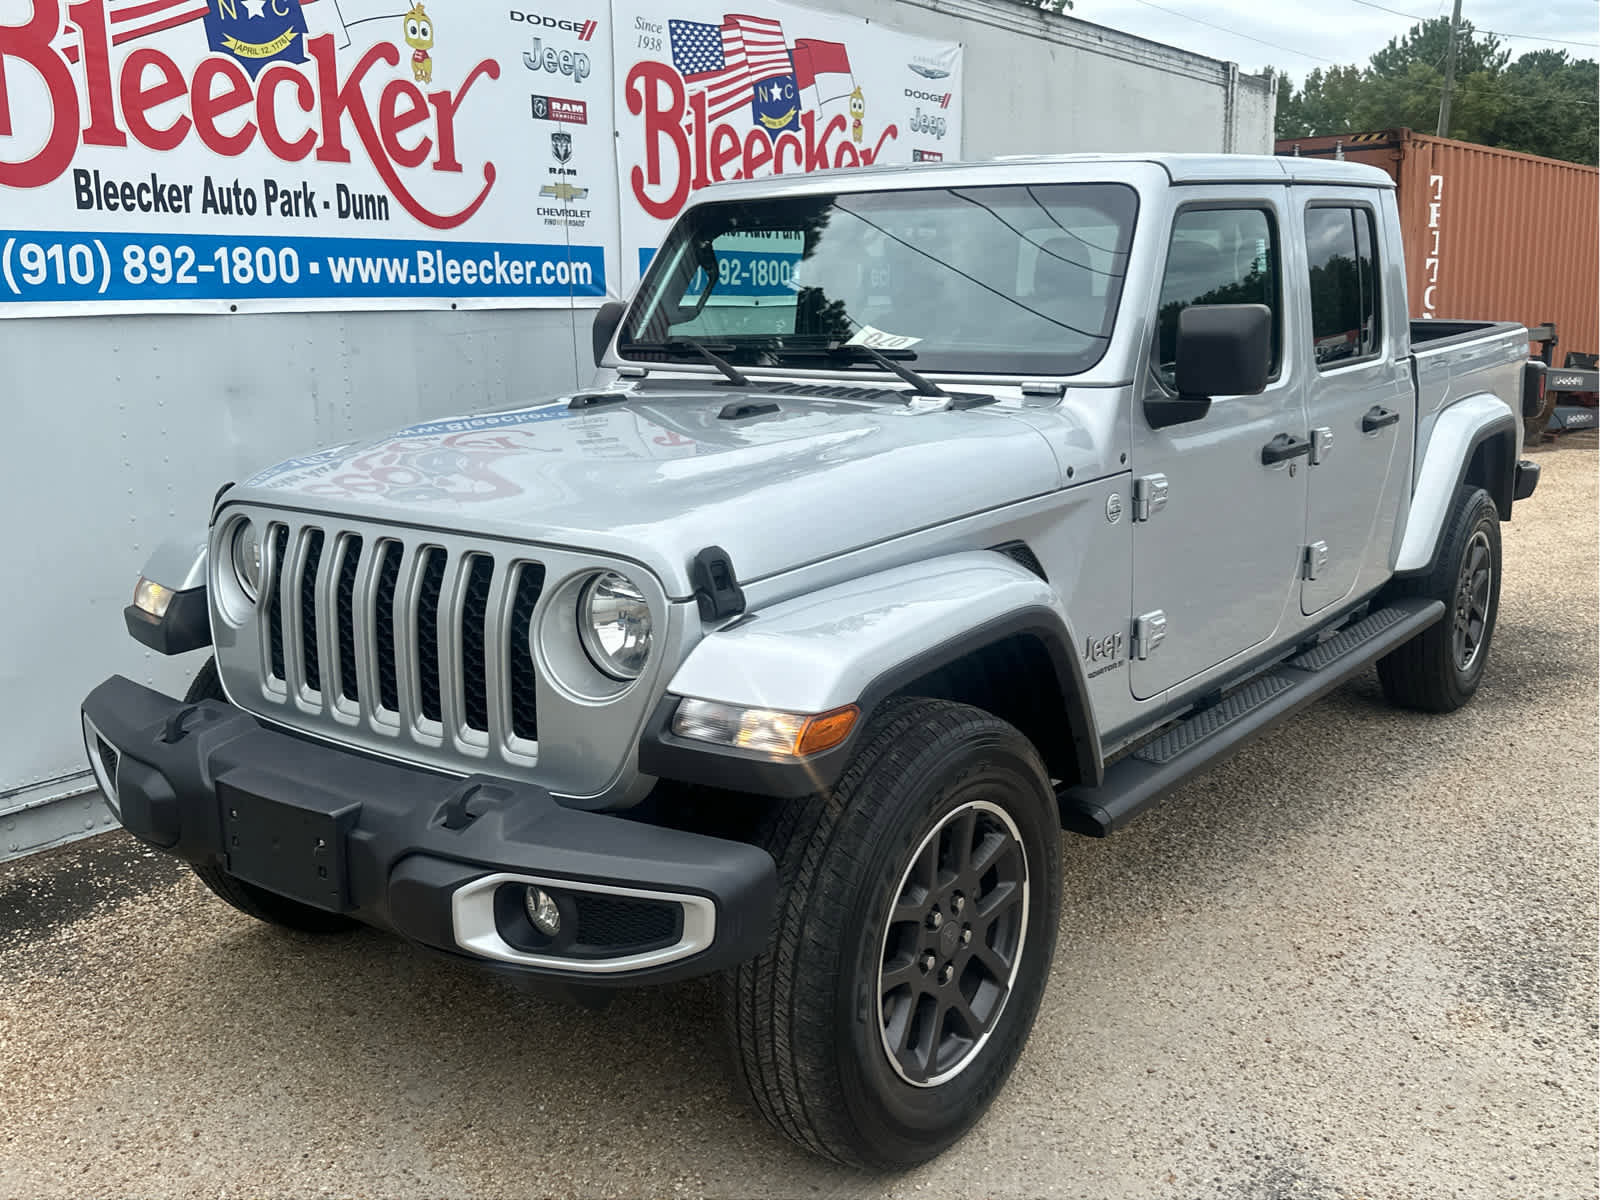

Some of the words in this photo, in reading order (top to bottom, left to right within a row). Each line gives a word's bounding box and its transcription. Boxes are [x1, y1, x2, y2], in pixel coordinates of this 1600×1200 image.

[509, 10, 587, 33] DODGE
[634, 16, 663, 34] Since
[236, 44, 259, 55] APRIL
[271, 37, 288, 52] 1776
[637, 34, 663, 51] 1938
[522, 37, 591, 83] Jeep
[758, 85, 769, 103] N
[784, 83, 794, 99] C
[904, 88, 946, 104] DODGE
[551, 101, 584, 113] RAM
[910, 107, 947, 140] Jeep
[548, 167, 577, 176] RAM
[74, 168, 193, 214] Bleecker
[202, 176, 257, 216] Auto
[264, 179, 317, 218] Park
[336, 183, 390, 221] Dunn
[536, 207, 592, 218] CHEVROLET
[2, 237, 112, 293] (910)
[123, 244, 299, 285] 892-1800
[328, 251, 593, 286] www.Bleecker.com
[719, 258, 790, 286] 92-1800
[1083, 631, 1122, 662] Jeep
